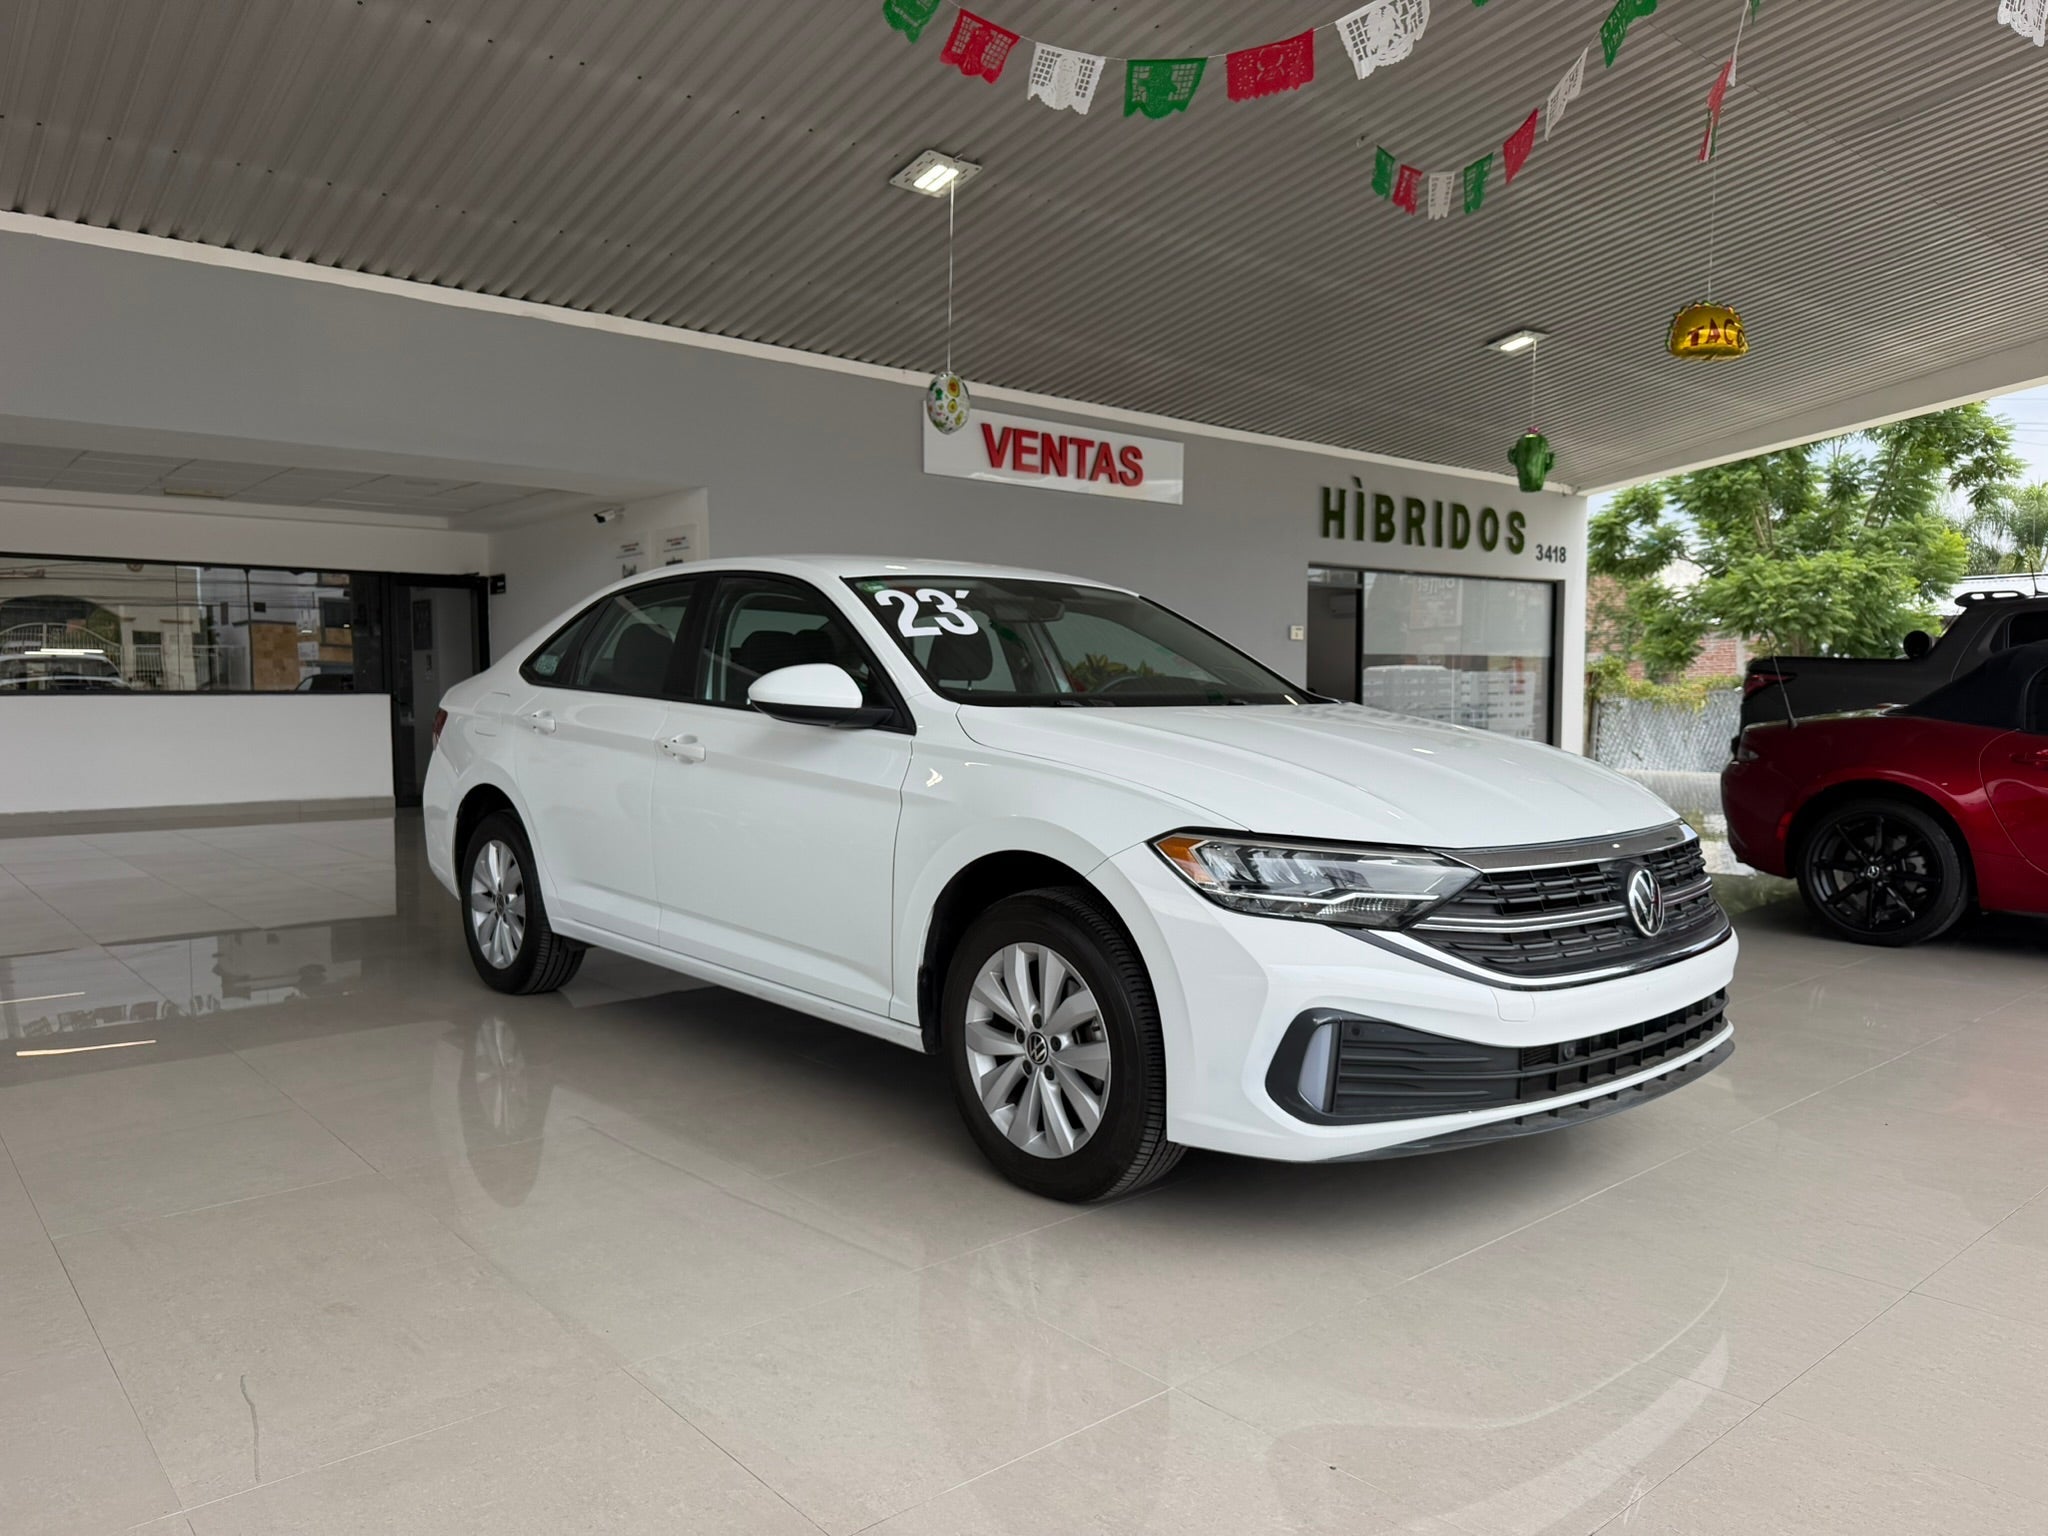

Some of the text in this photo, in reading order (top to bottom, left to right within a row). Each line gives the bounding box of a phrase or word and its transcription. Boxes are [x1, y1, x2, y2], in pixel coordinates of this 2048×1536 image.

[980, 423, 1144, 487] VENTAS
[1320, 476, 1526, 555] HÌBRIDOS
[1535, 544, 1567, 563] 3418
